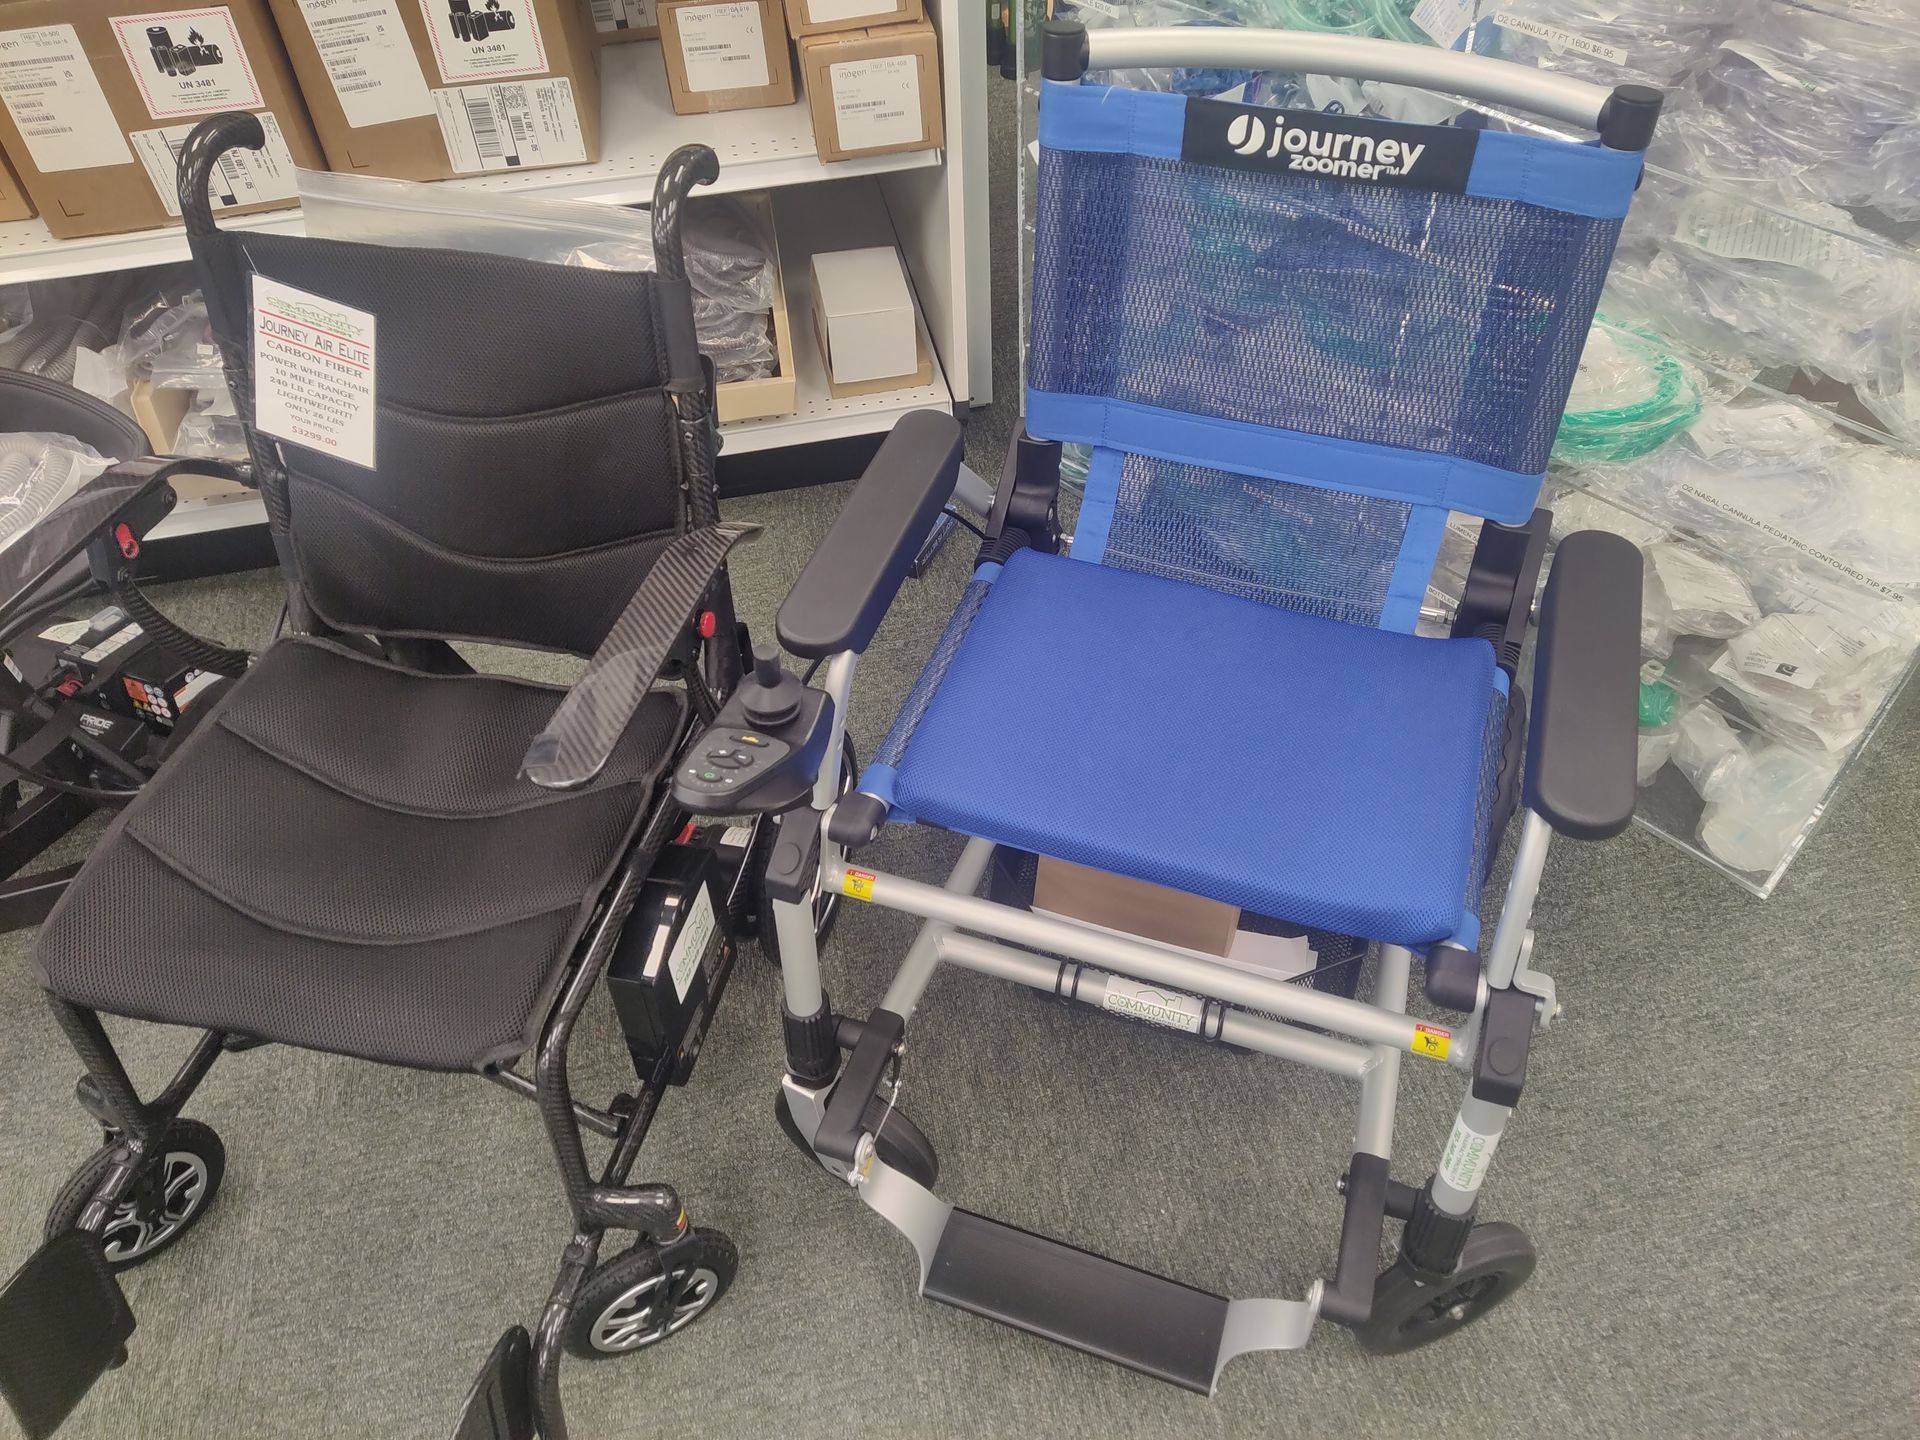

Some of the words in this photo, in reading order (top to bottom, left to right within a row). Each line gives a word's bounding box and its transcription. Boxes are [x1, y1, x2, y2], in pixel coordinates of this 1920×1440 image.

[684, 12, 712, 22] inogen
[1497, 14, 1508, 25] O2
[1510, 19, 1549, 38] CANNULA
[1551, 31, 1557, 39] 7
[1559, 34, 1569, 43] FT
[1571, 38, 1591, 51] 1600
[1591, 44, 1615, 59] $6.95
[471, 46, 485, 54] UN
[487, 44, 507, 52] 3481
[178, 80, 194, 89] UN
[195, 78, 216, 87] 3481
[839, 69, 867, 79] inogen
[495, 98, 507, 120] GROUND
[523, 111, 531, 120] NJ
[231, 149, 238, 158] NJ
[1266, 115, 1426, 175] journey
[234, 159, 244, 170] 087
[266, 296, 364, 334] COMMUNITY
[259, 316, 309, 344] JOURNEY
[314, 335, 333, 353] AIR
[338, 343, 369, 366] ELITE
[266, 340, 321, 365] CARBON
[325, 359, 363, 379] FIBER
[259, 352, 297, 370] POWER
[300, 365, 369, 394] WHEELCHAIR
[275, 368, 287, 377] 10
[290, 372, 315, 386] MILE
[317, 382, 355, 400] RANGE
[269, 376, 288, 387] 240
[291, 383, 304, 393] LB
[307, 389, 360, 411] CAPACITY
[276, 388, 353, 420] LIGHTWEIGHT!
[284, 401, 311, 415] ONLY
[312, 410, 324, 419] 26
[326, 415, 345, 427] LBS
[290, 413, 312, 426] YOUR
[313, 422, 334, 435] PRICE
[291, 425, 337, 447] $3299.00
[1449, 521, 1472, 539] LUMEN
[1681, 483, 1694, 494] O2
[1693, 489, 1721, 507] NASAL
[1722, 503, 1762, 528] CANNULA
[1762, 524, 1808, 551] PEDIATRIC
[1808, 548, 1864, 581] CONTOURED
[1865, 577, 1880, 589] TIP
[1879, 585, 1905, 603] $7.95
[80, 713, 115, 729] PRIDE
[1108, 994, 1194, 1026] COMMUNITY
[1425, 1027, 1451, 1038] DANGER
[1456, 1136, 1487, 1190] COMMUNITY
